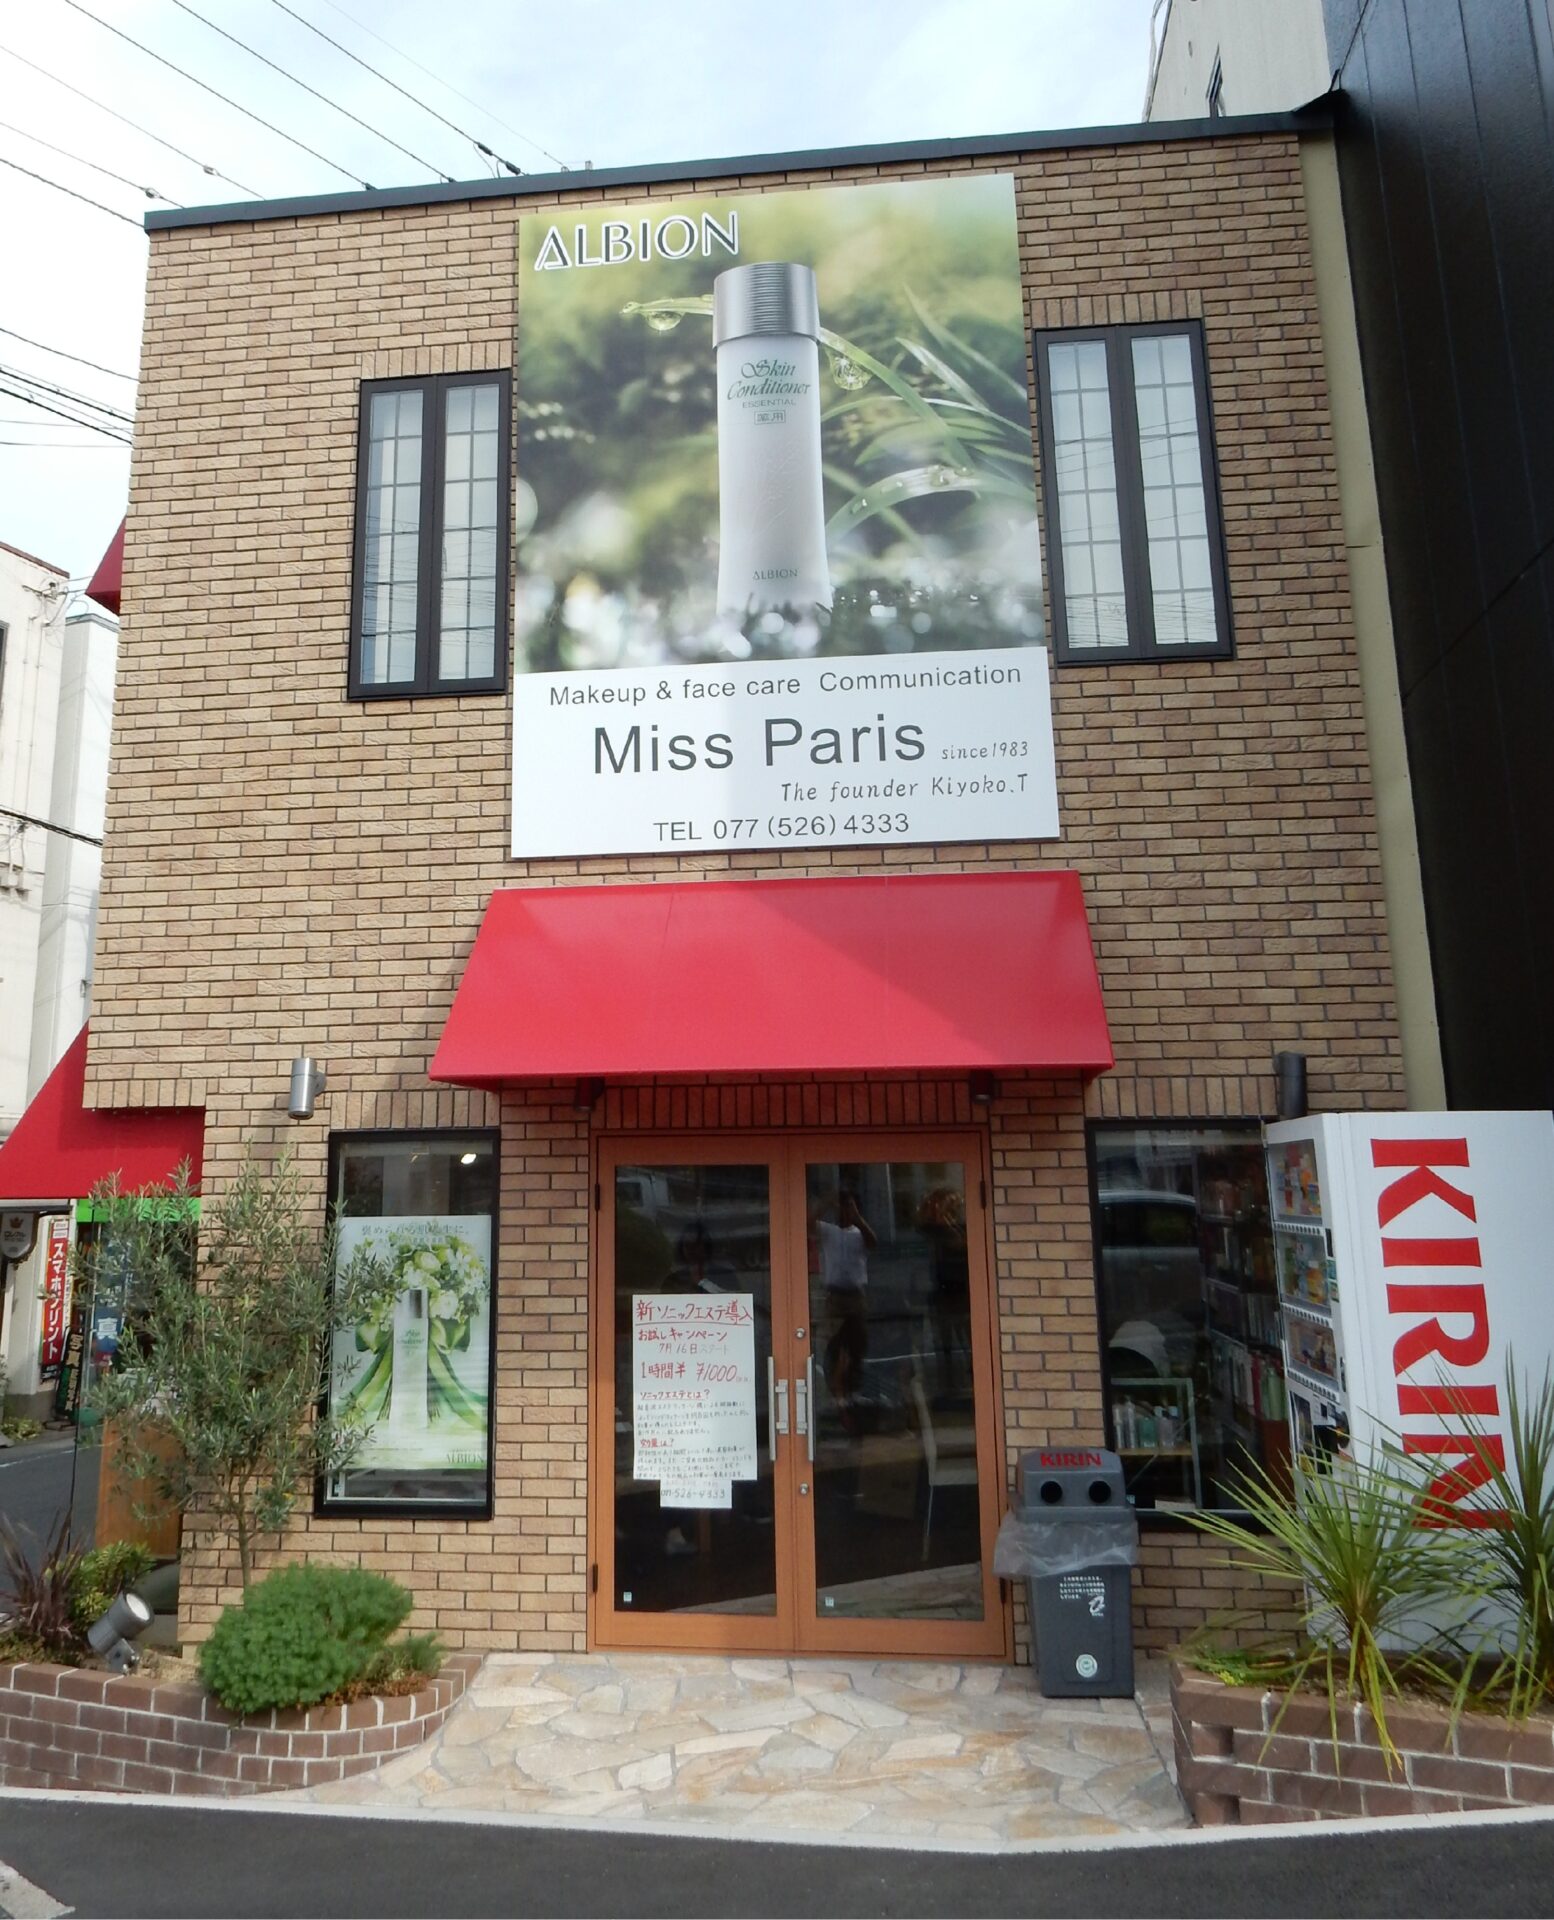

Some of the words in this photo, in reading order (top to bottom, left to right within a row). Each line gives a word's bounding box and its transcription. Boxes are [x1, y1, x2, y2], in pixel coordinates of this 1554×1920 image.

[534, 211, 739, 271] ALBION
[741, 359, 796, 378] Skin
[727, 378, 811, 400] Conditioner
[742, 399, 796, 409] ESSENTIAL
[752, 569, 798, 580] ALBION
[551, 687, 646, 707] Makeup
[657, 681, 672, 699] &
[683, 680, 735, 698] face
[747, 679, 801, 695] care
[820, 666, 1021, 691] Communication
[595, 725, 734, 773] Miss
[765, 714, 925, 767] Paris
[782, 783, 816, 801] The
[830, 779, 919, 802] founder
[932, 774, 1028, 797] Kiyoko.T
[654, 822, 701, 841] TEL
[1371, 1138, 1514, 1530] KIRIN
[1039, 1452, 1102, 1469] KIRIN
